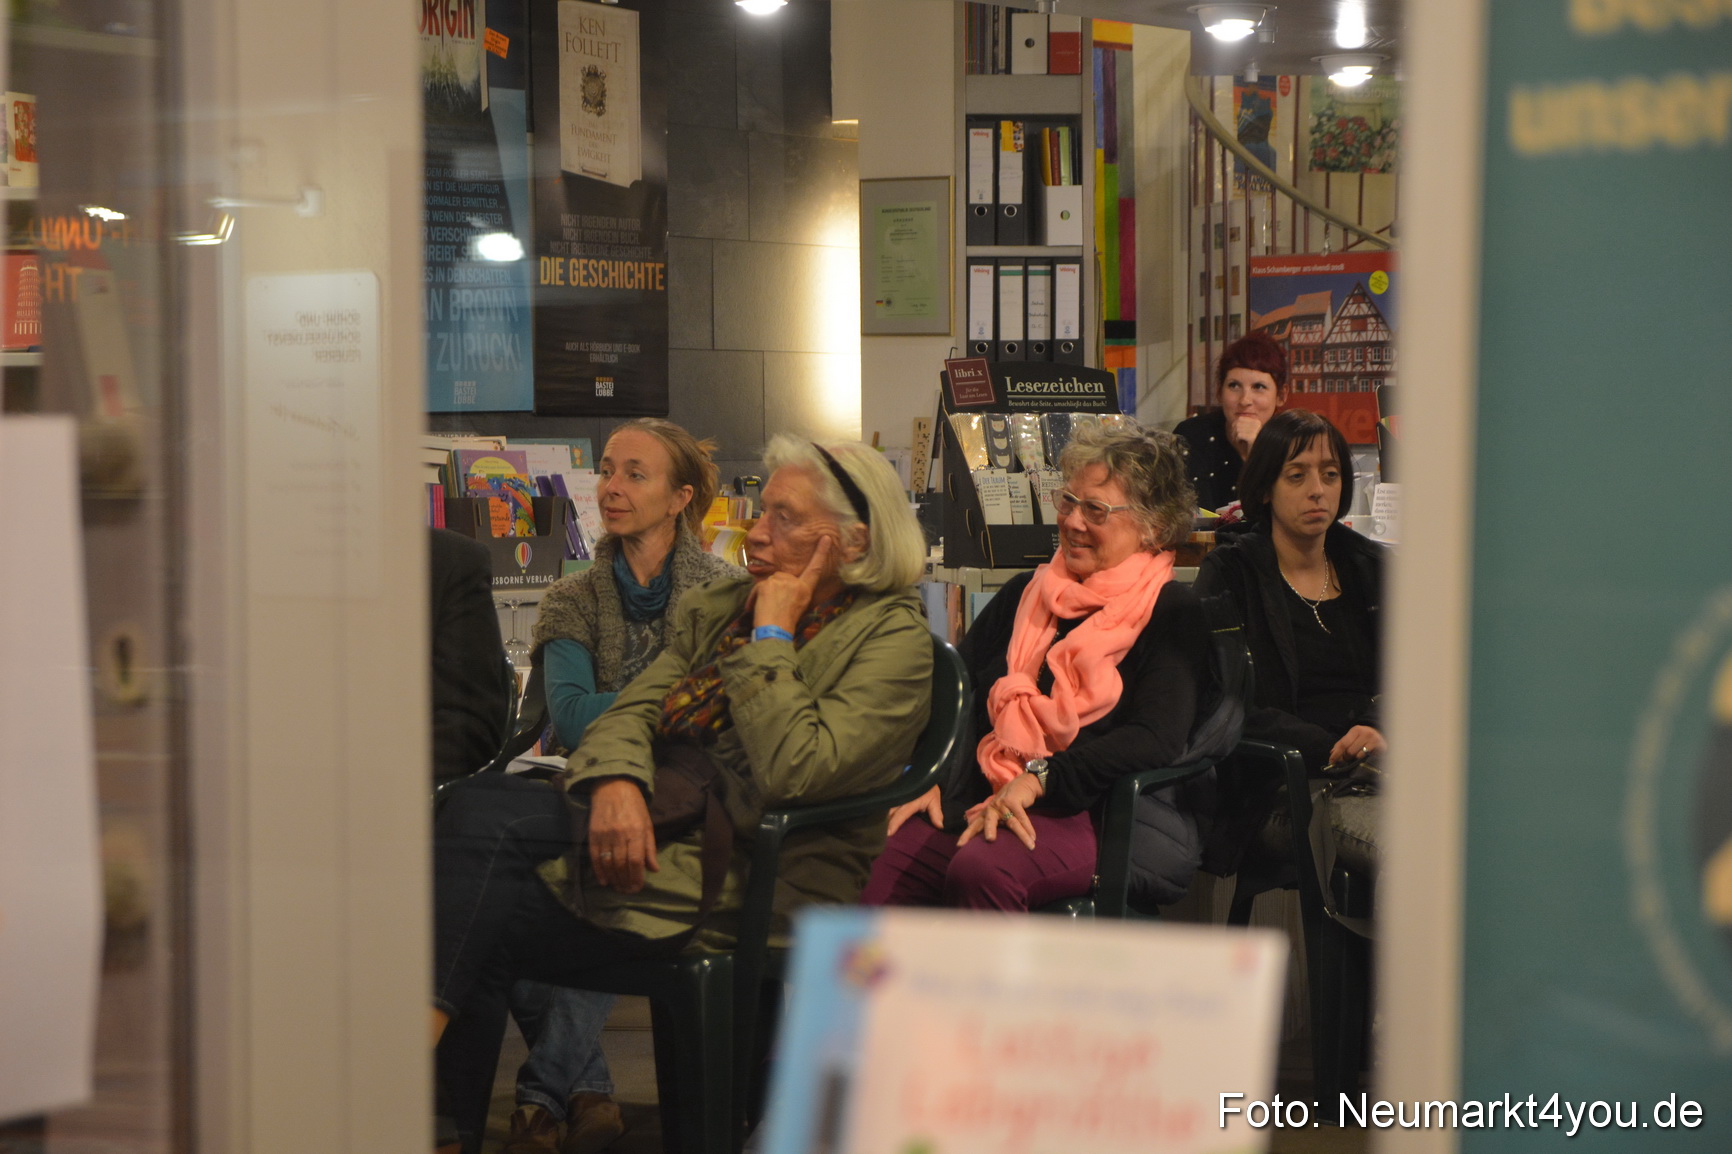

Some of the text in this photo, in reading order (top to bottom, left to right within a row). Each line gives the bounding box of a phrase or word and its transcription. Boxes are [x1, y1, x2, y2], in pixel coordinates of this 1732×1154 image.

[579, 16, 606, 37] KEN
[565, 31, 621, 63] FOLLETT
[571, 123, 617, 146] FUNDAMENT
[434, 182, 443, 191] IST
[445, 182, 457, 192] DIE
[432, 210, 453, 222] WENN
[561, 213, 580, 227] NICHT
[563, 227, 582, 241] NICHT
[540, 256, 665, 291] DIE GESCHICHTE
[449, 288, 518, 322] BROWN
[595, 382, 614, 390] BASTEI
[1004, 375, 1105, 393] Lesezeichen
[526, 574, 554, 585] VERLAG
